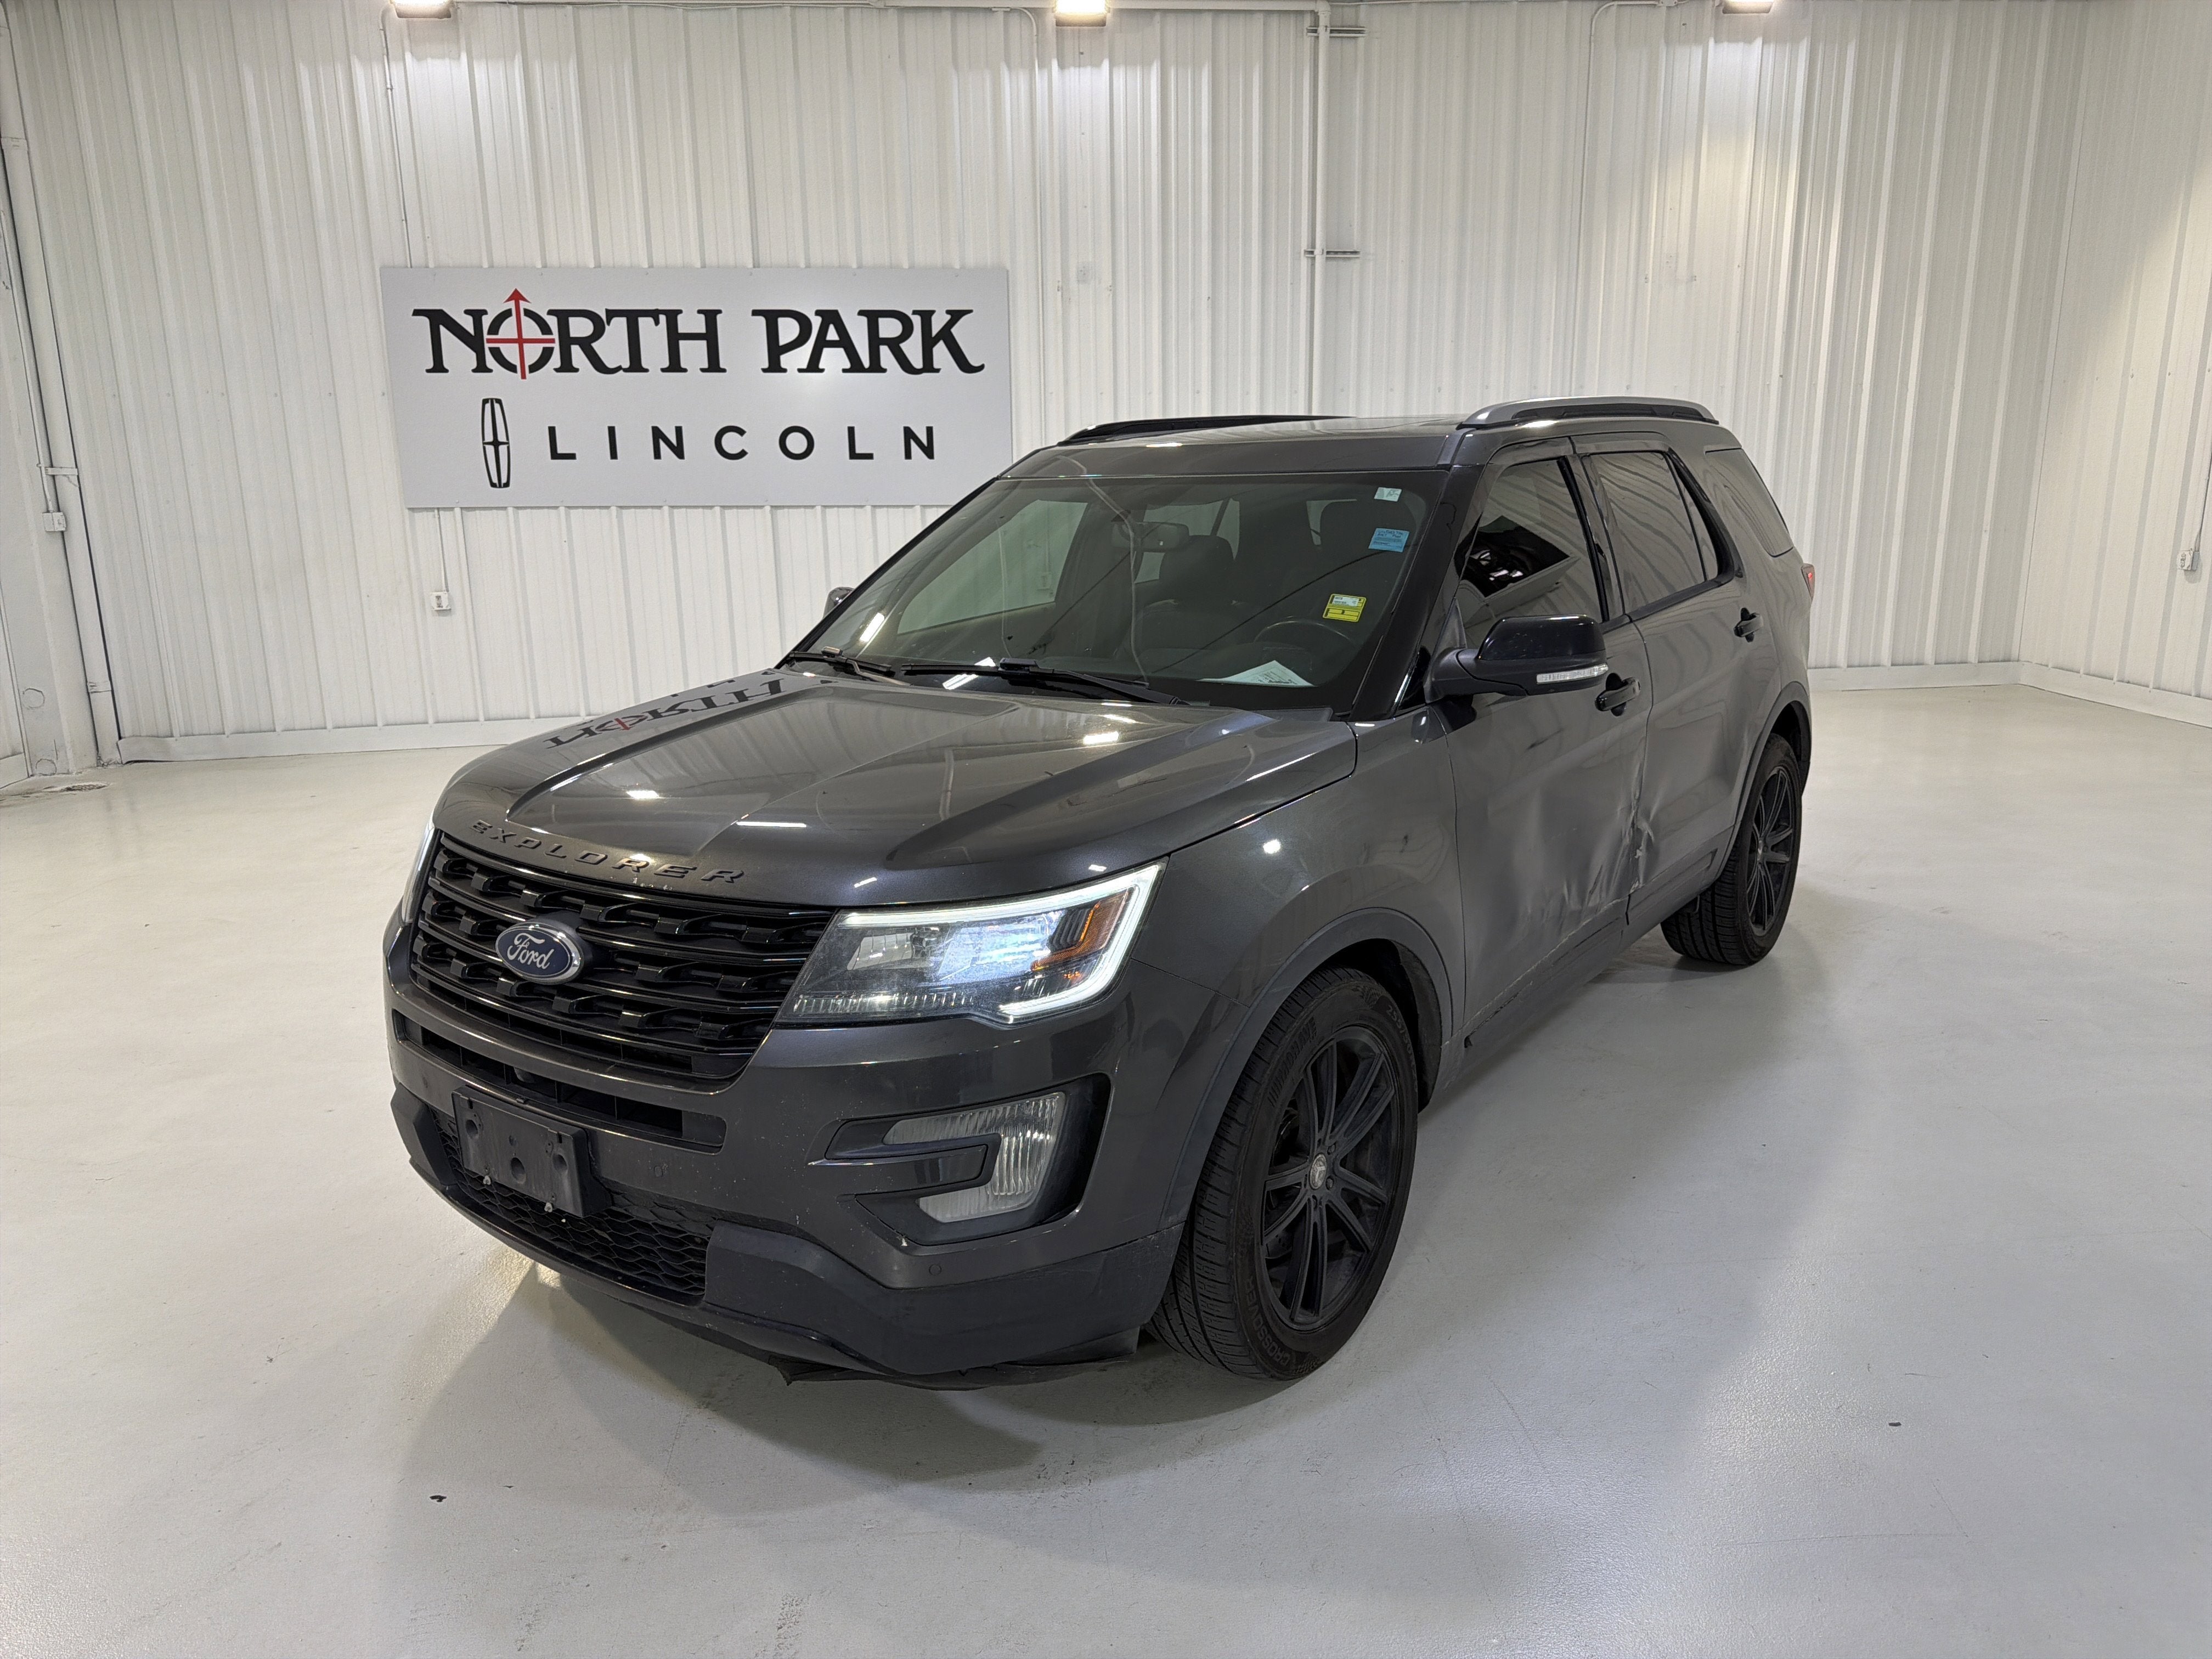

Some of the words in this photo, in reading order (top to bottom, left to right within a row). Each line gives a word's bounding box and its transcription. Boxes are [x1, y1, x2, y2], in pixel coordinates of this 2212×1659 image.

[412, 307, 726, 375] NORTH
[752, 308, 985, 375] PARK
[548, 425, 935, 461] LINCOLN
[470, 820, 745, 884] EXPLORER
[506, 932, 555, 970] Ford
